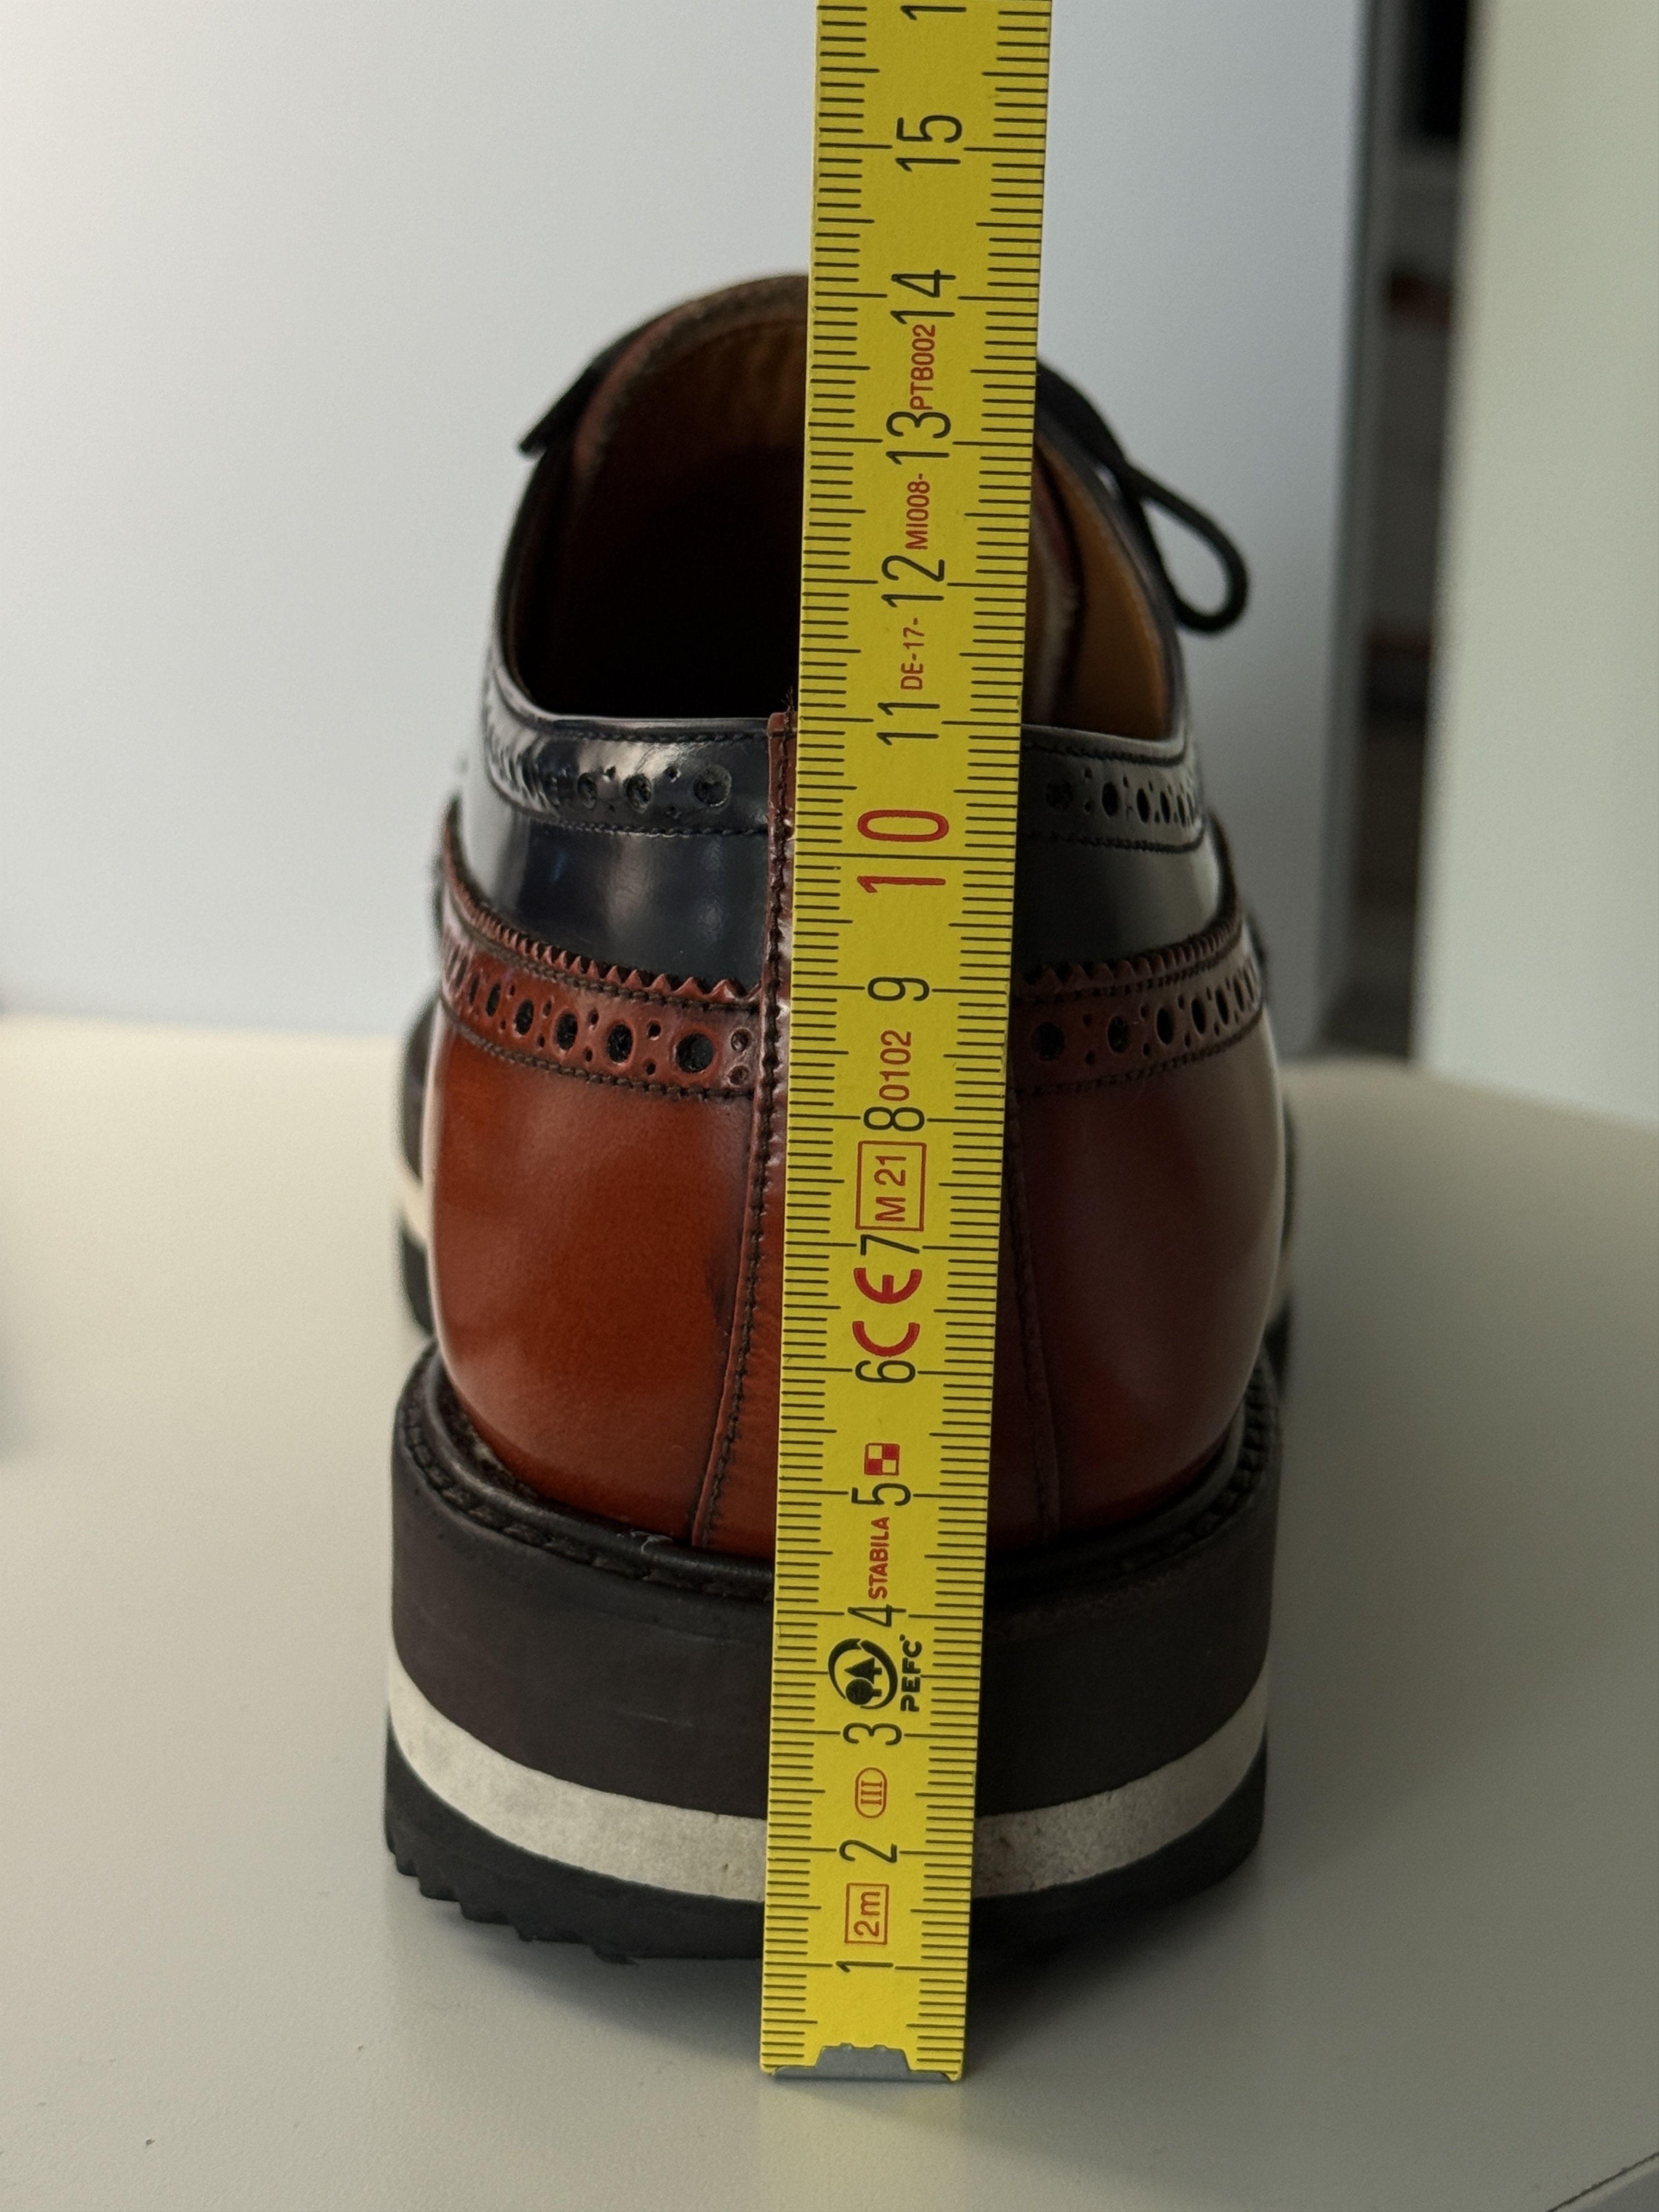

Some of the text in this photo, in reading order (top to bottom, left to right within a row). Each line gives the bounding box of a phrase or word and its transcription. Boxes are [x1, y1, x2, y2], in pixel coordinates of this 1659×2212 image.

[895, 115, 963, 172] 15
[890, 269, 957, 325] 14
[910, 324, 936, 410] PTB002
[885, 411, 951, 465] 13
[905, 473, 930, 550] MI008-
[880, 555, 945, 608] 12
[900, 618, 925, 690] DE-17-
[877, 702, 940, 746] 11
[857, 810, 949, 893] 10
[867, 976, 930, 1001] 9
[879, 1029, 912, 1101] 0102
[863, 1106, 925, 1132] 8
[874, 1155, 907, 1222] M 21
[860, 1234, 920, 1256] 7
[852, 1267, 922, 1357] CE
[855, 1359, 916, 1384] 6
[851, 1483, 912, 1506] 5
[868, 1516, 890, 1600] STABILA
[847, 1604, 907, 1627] 4
[900, 1639, 922, 1712] PEFC
[842, 1722, 902, 1746] 3
[860, 1780, 884, 1806] III
[839, 1839, 898, 1863] 2
[854, 1891, 881, 1937] 2m
[835, 1960, 894, 1973] 1
